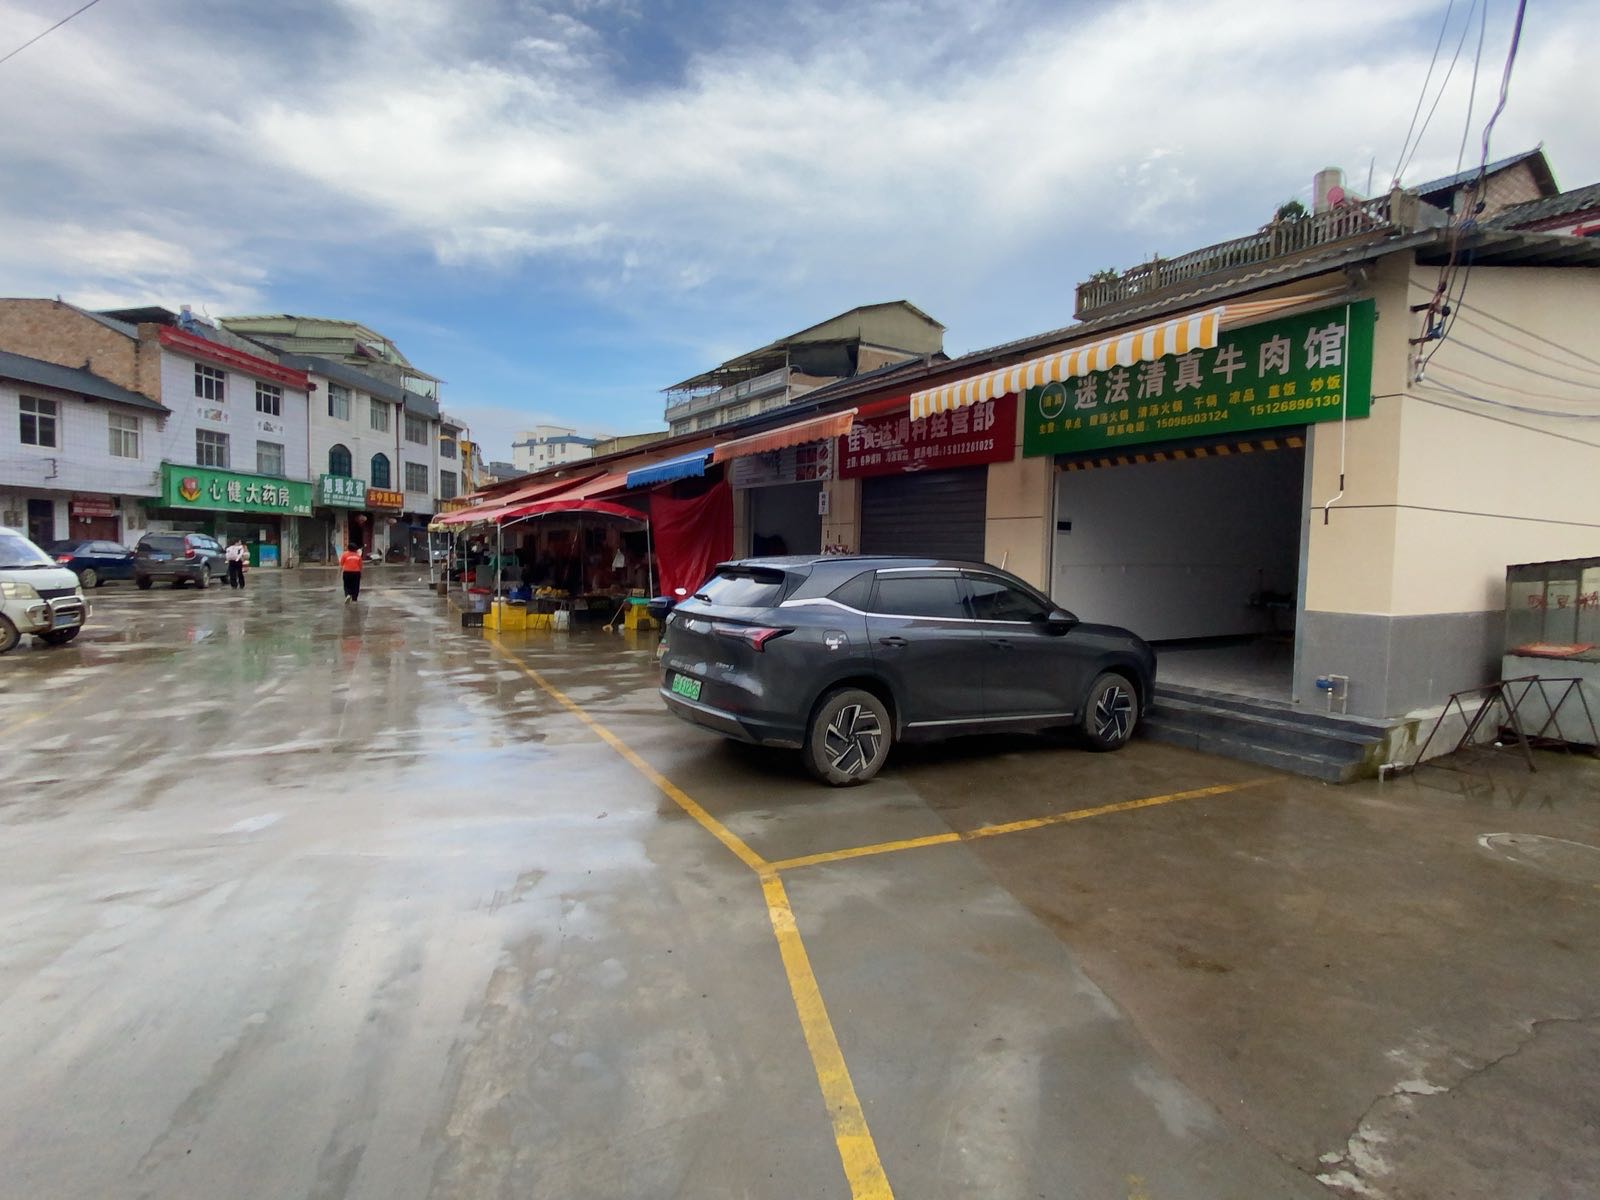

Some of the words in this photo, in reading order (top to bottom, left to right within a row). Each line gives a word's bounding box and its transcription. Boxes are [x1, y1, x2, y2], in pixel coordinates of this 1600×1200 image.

[1074, 322, 1345, 411] 迷法清真牛肉馆
[209, 479, 290, 507] 心健大药房
